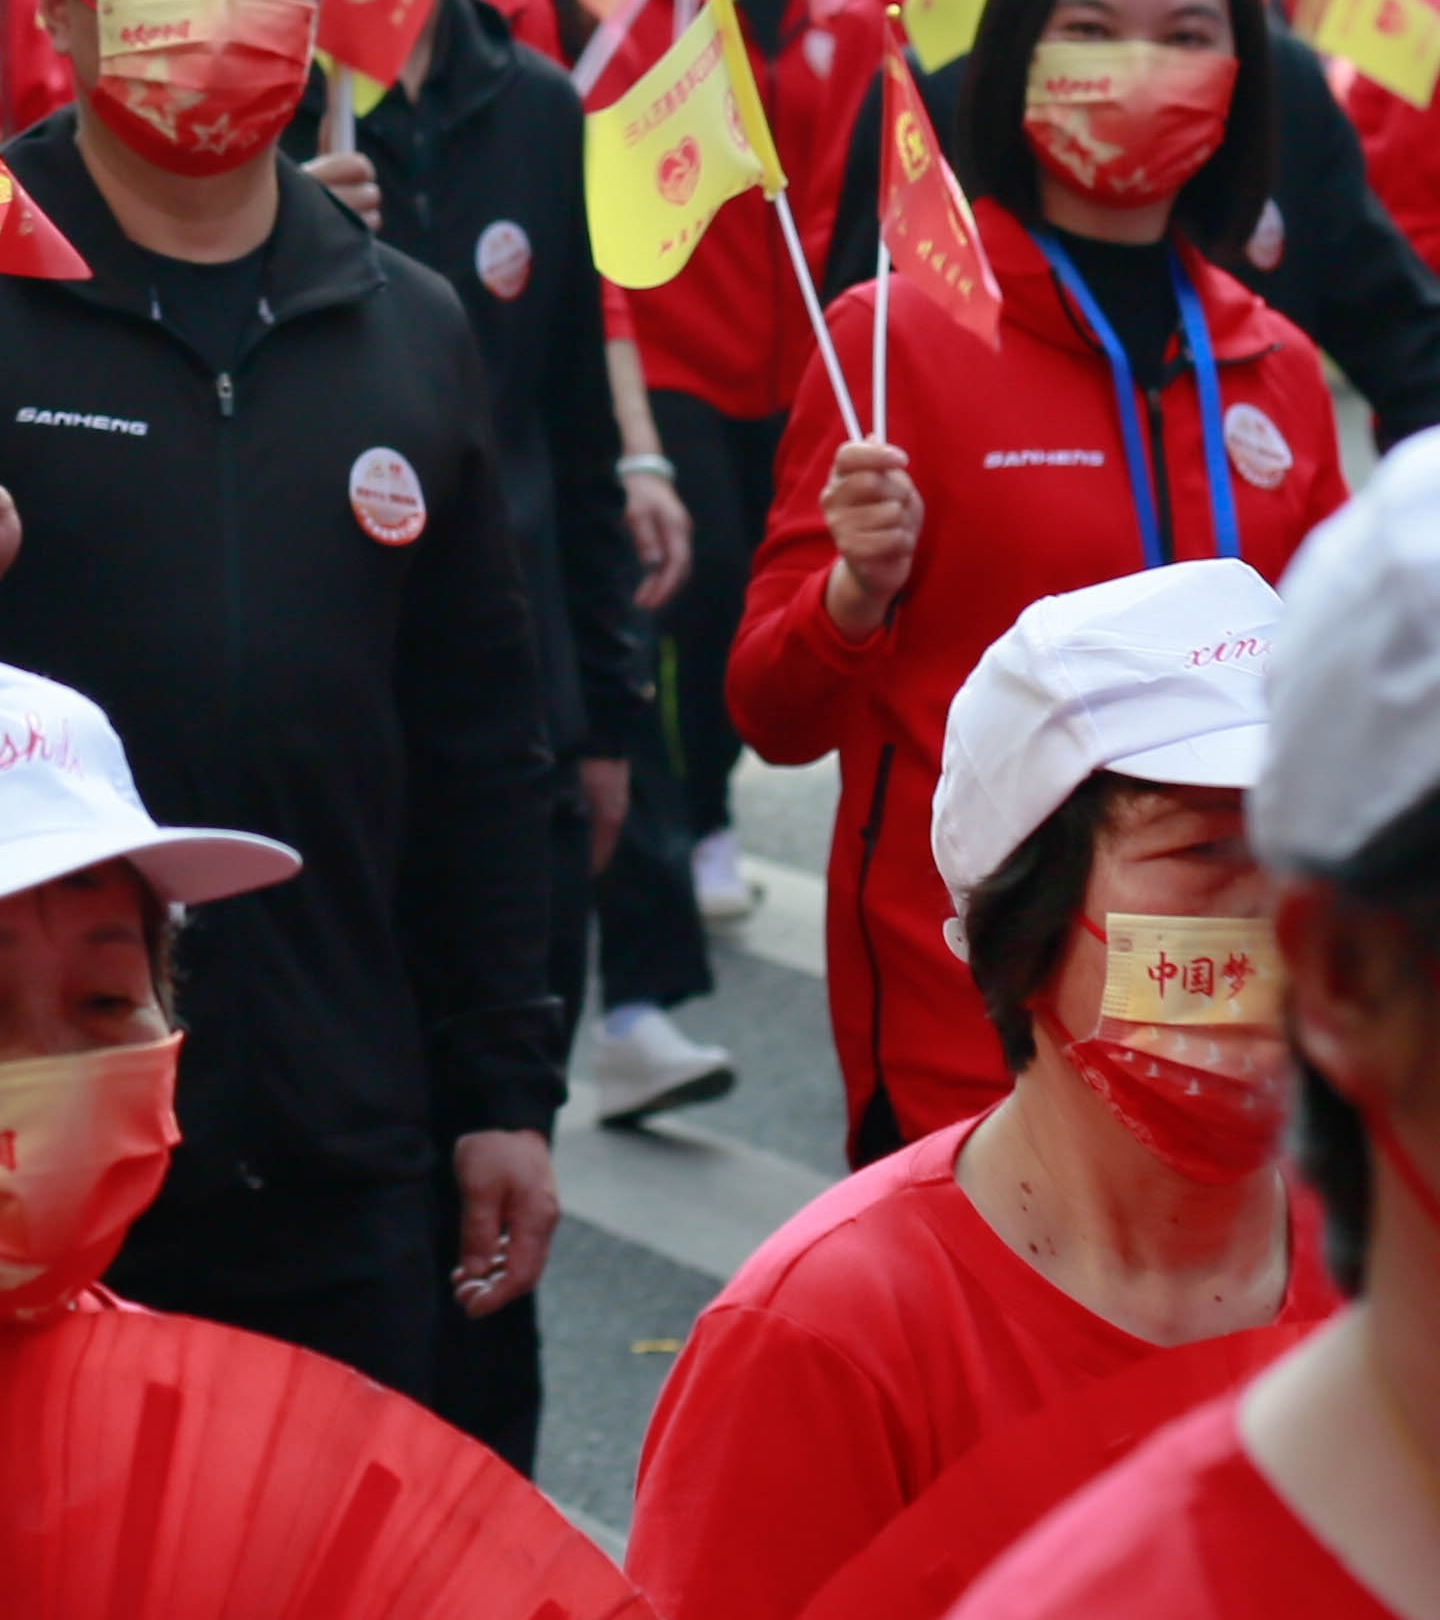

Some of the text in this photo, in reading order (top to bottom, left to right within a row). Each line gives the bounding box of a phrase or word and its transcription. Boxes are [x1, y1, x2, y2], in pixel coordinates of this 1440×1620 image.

[16, 406, 148, 436] SANHENG
[1147, 951, 1257, 1000] 中国梦
